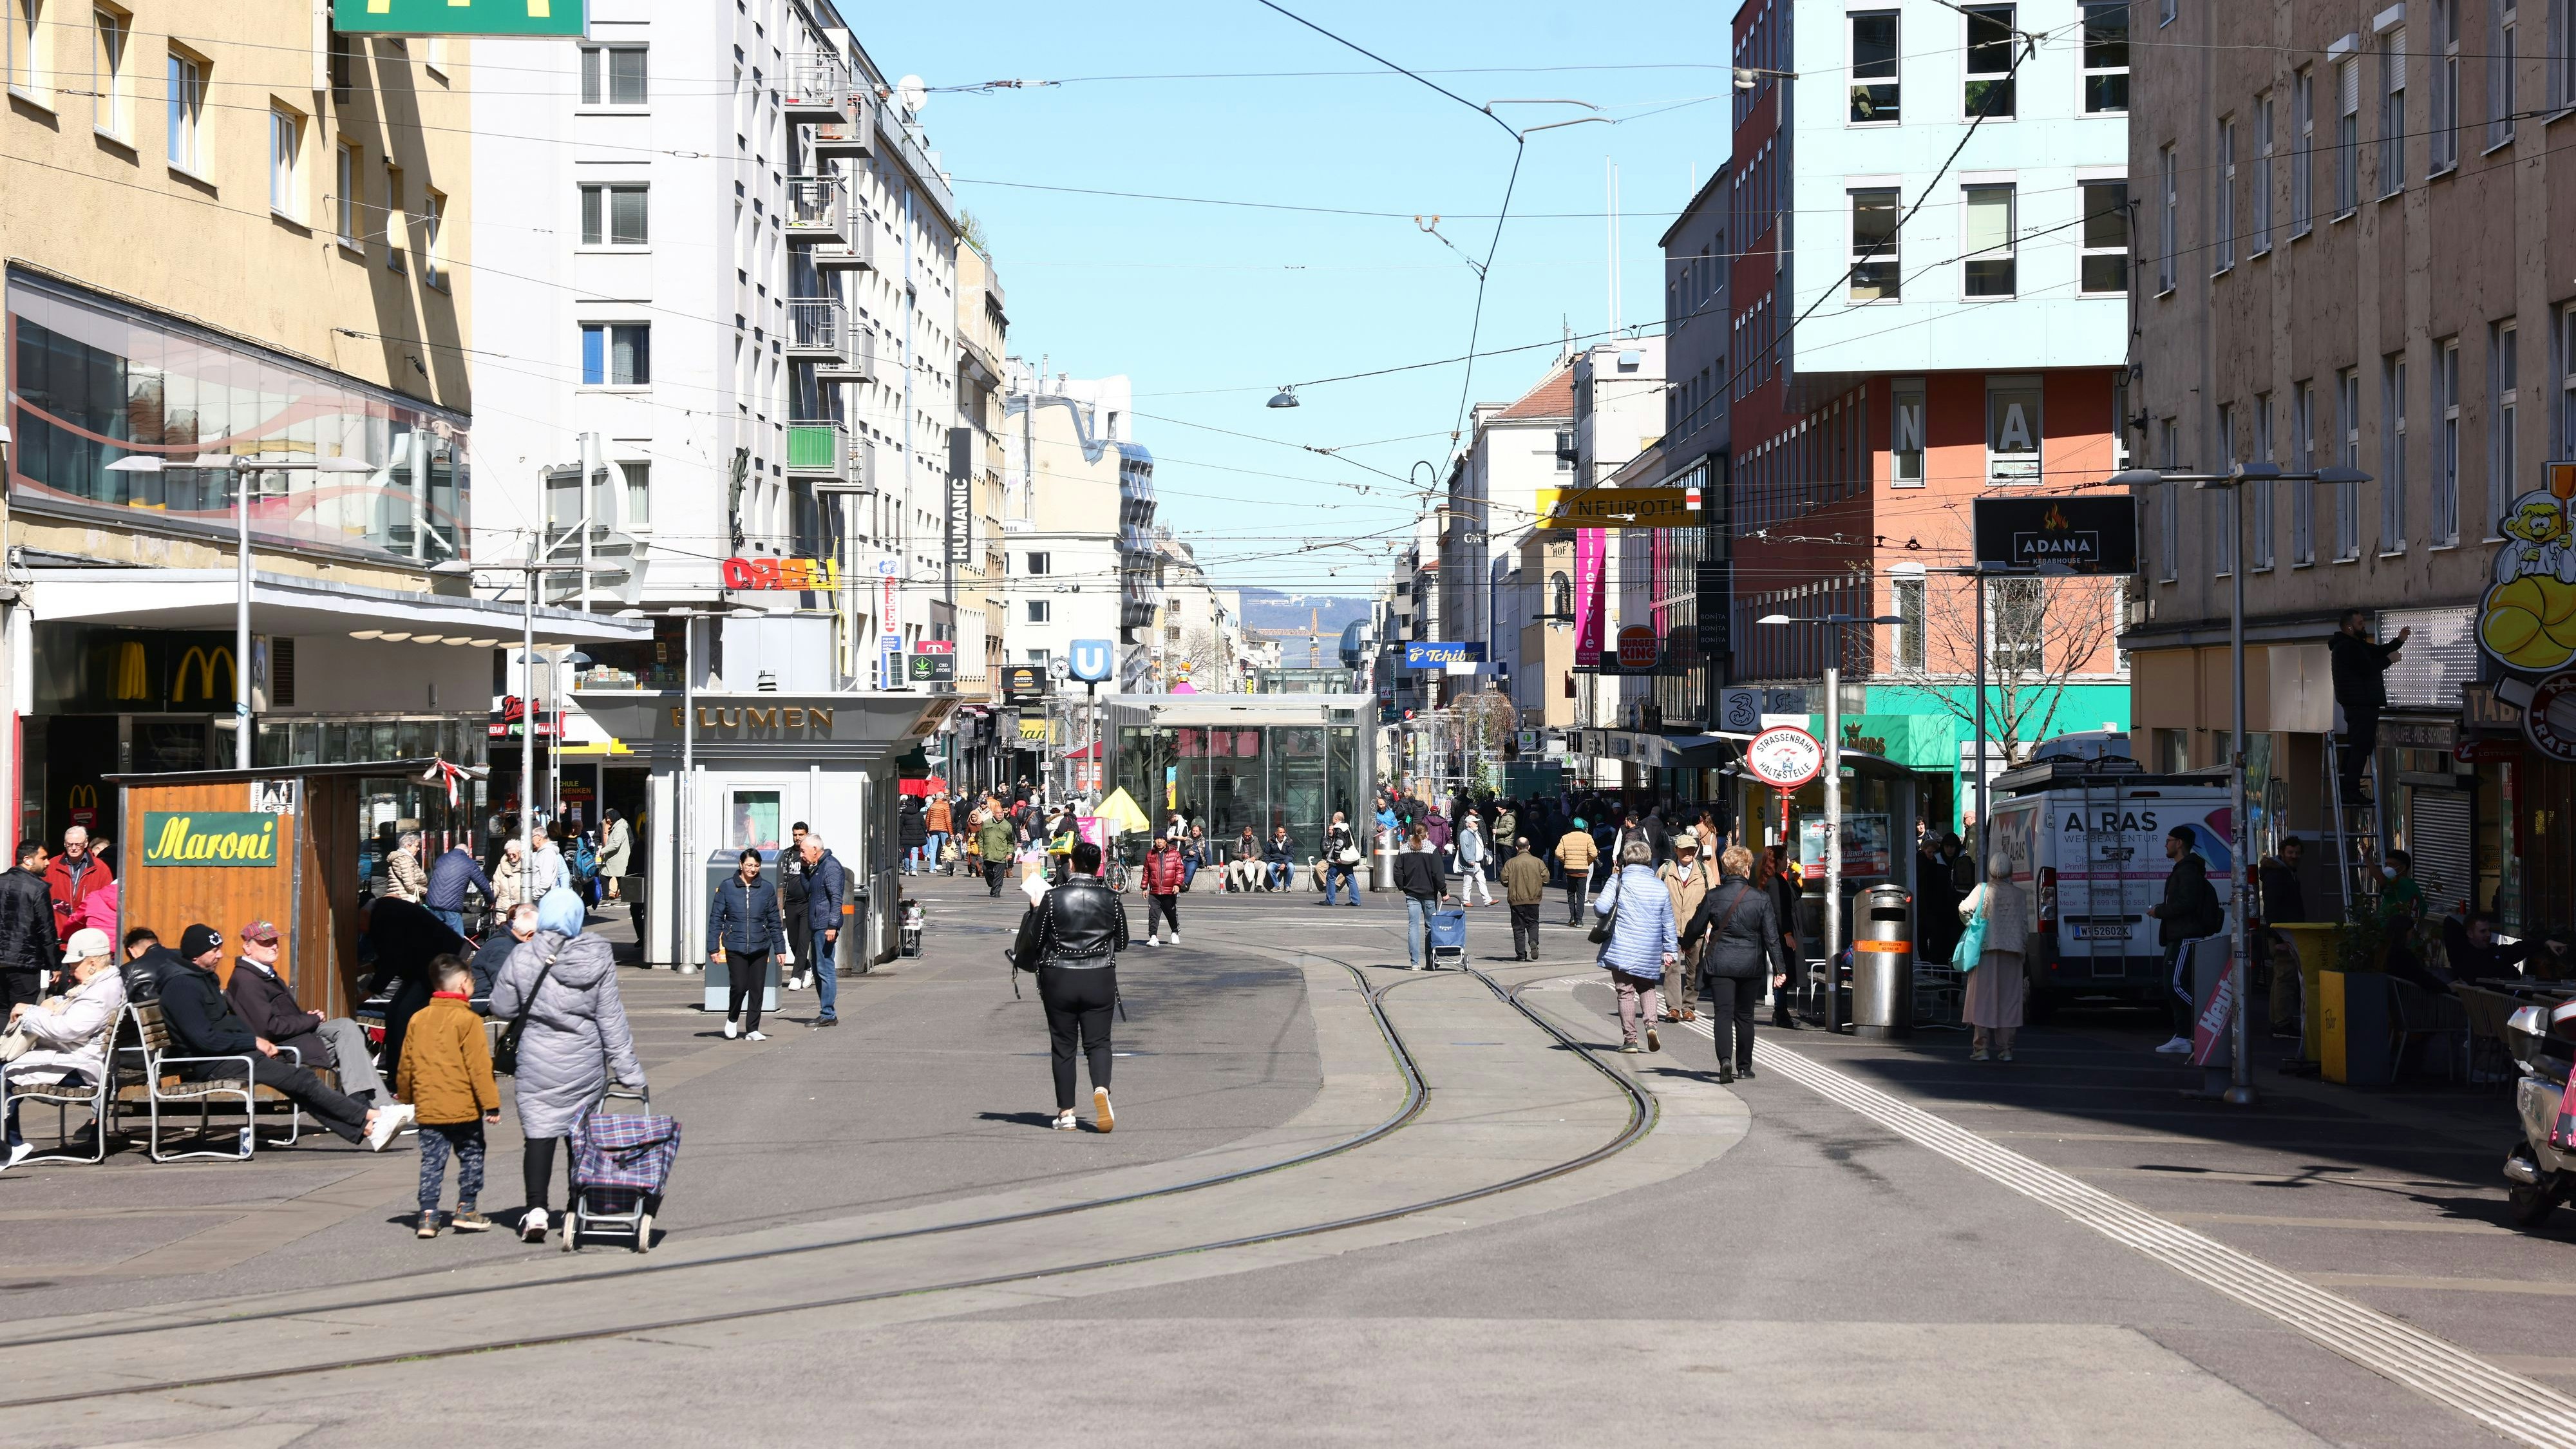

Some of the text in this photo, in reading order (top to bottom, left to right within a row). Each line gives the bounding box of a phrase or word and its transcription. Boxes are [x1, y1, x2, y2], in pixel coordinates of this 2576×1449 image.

[1998, 403, 2033, 450] A
[1578, 500, 1684, 516] NEUROTH
[952, 478, 967, 560] HUMANIC
[1553, 545, 1566, 557] HOF
[2023, 538, 2090, 553] ADANA
[1619, 639, 1656, 648] BURGER
[1077, 647, 1104, 676] U
[1426, 649, 1477, 663] Tchibo
[1620, 647, 1657, 659] KING
[1757, 733, 1815, 753] STRASSENBAHN
[1758, 762, 1812, 780] HALTESTELLE
[2063, 811, 2158, 832] ALRAS
[147, 816, 273, 860] Maroni
[2064, 835, 2158, 843] WERBEAGENTUR
[2010, 841, 2025, 861] ALRAS
